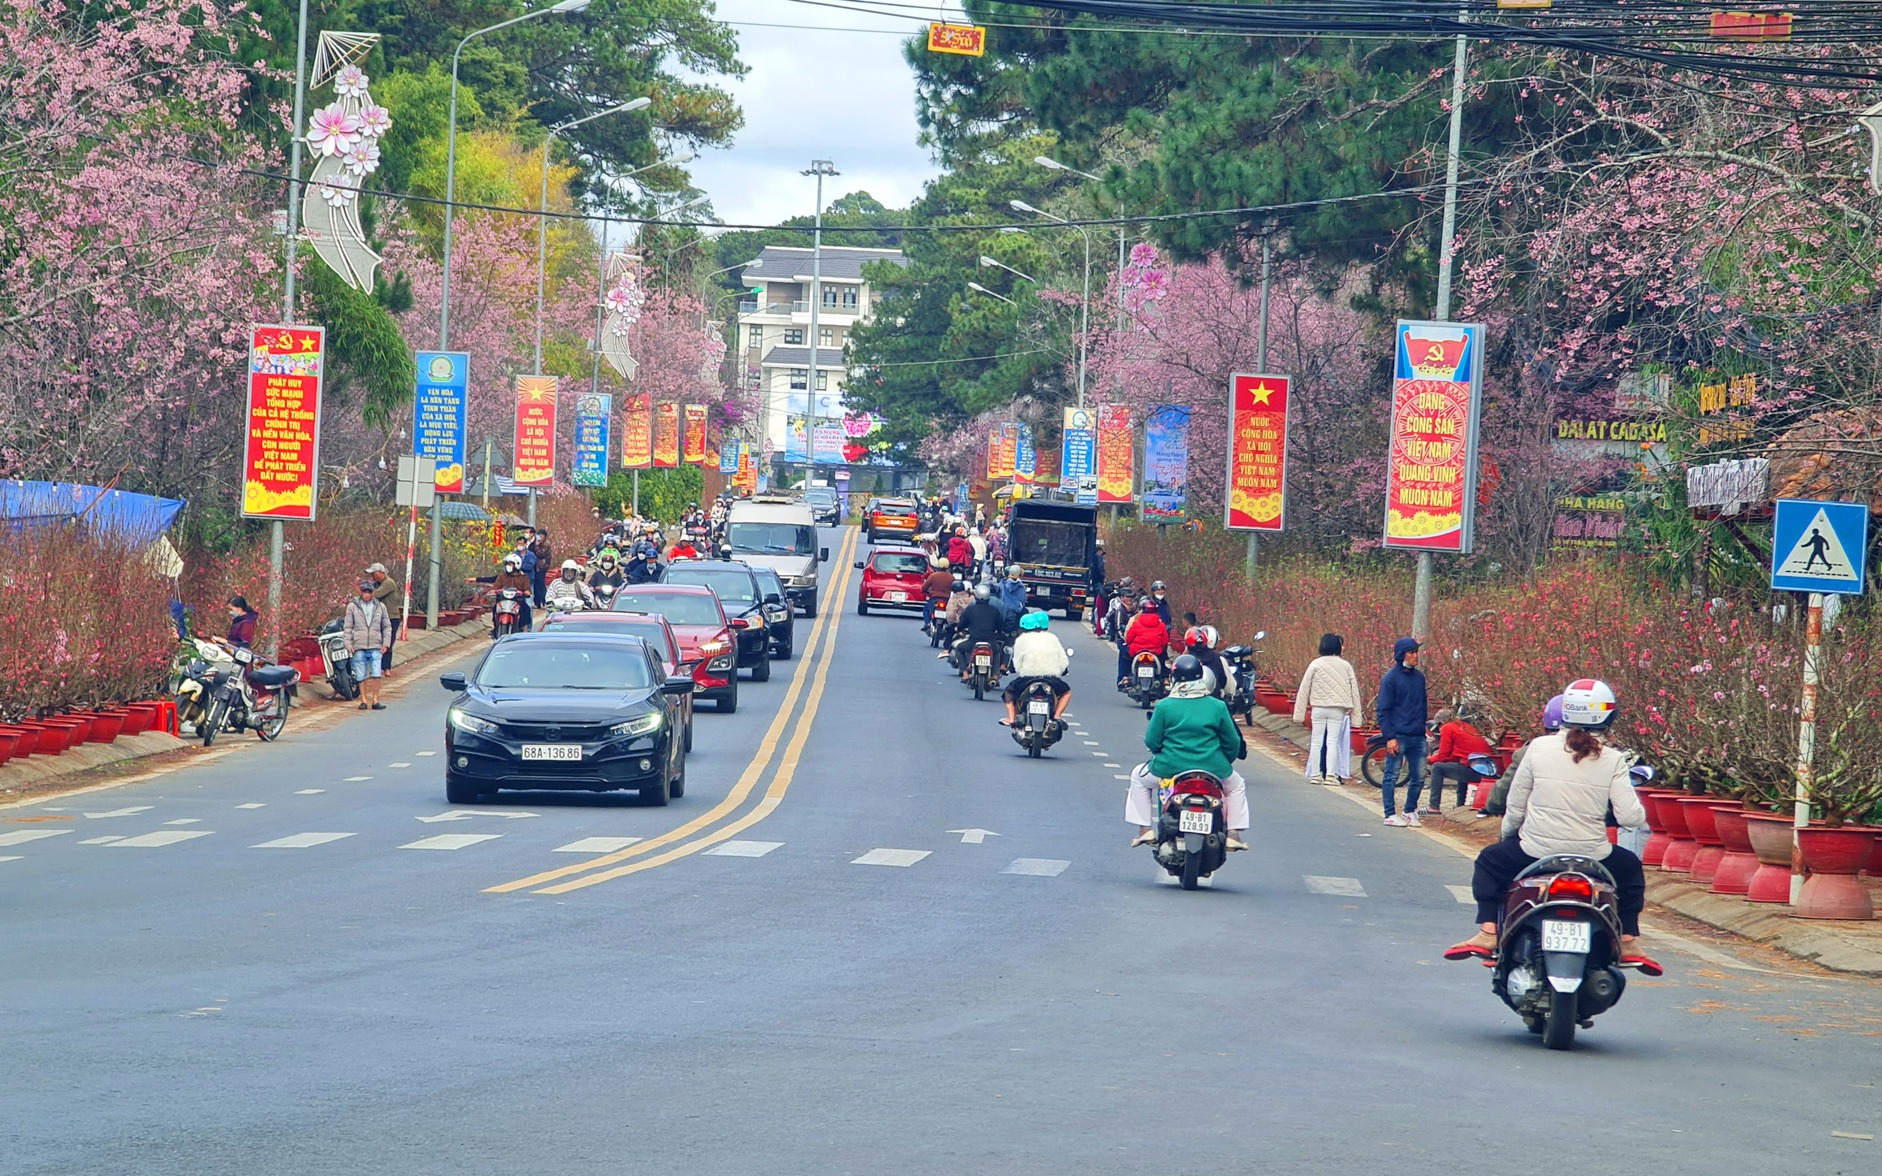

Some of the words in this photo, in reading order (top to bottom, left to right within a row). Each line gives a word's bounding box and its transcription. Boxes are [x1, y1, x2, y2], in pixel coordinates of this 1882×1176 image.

[1429, 442, 1451, 458] NAM
[1259, 467, 1275, 476] NAM
[1400, 464, 1430, 481] QUANG
[1434, 466, 1456, 483] VINH
[1186, 813, 1206, 822] 49-B1
[1551, 923, 1581, 936] 49-B1
[1546, 937, 1586, 950] 937.72
